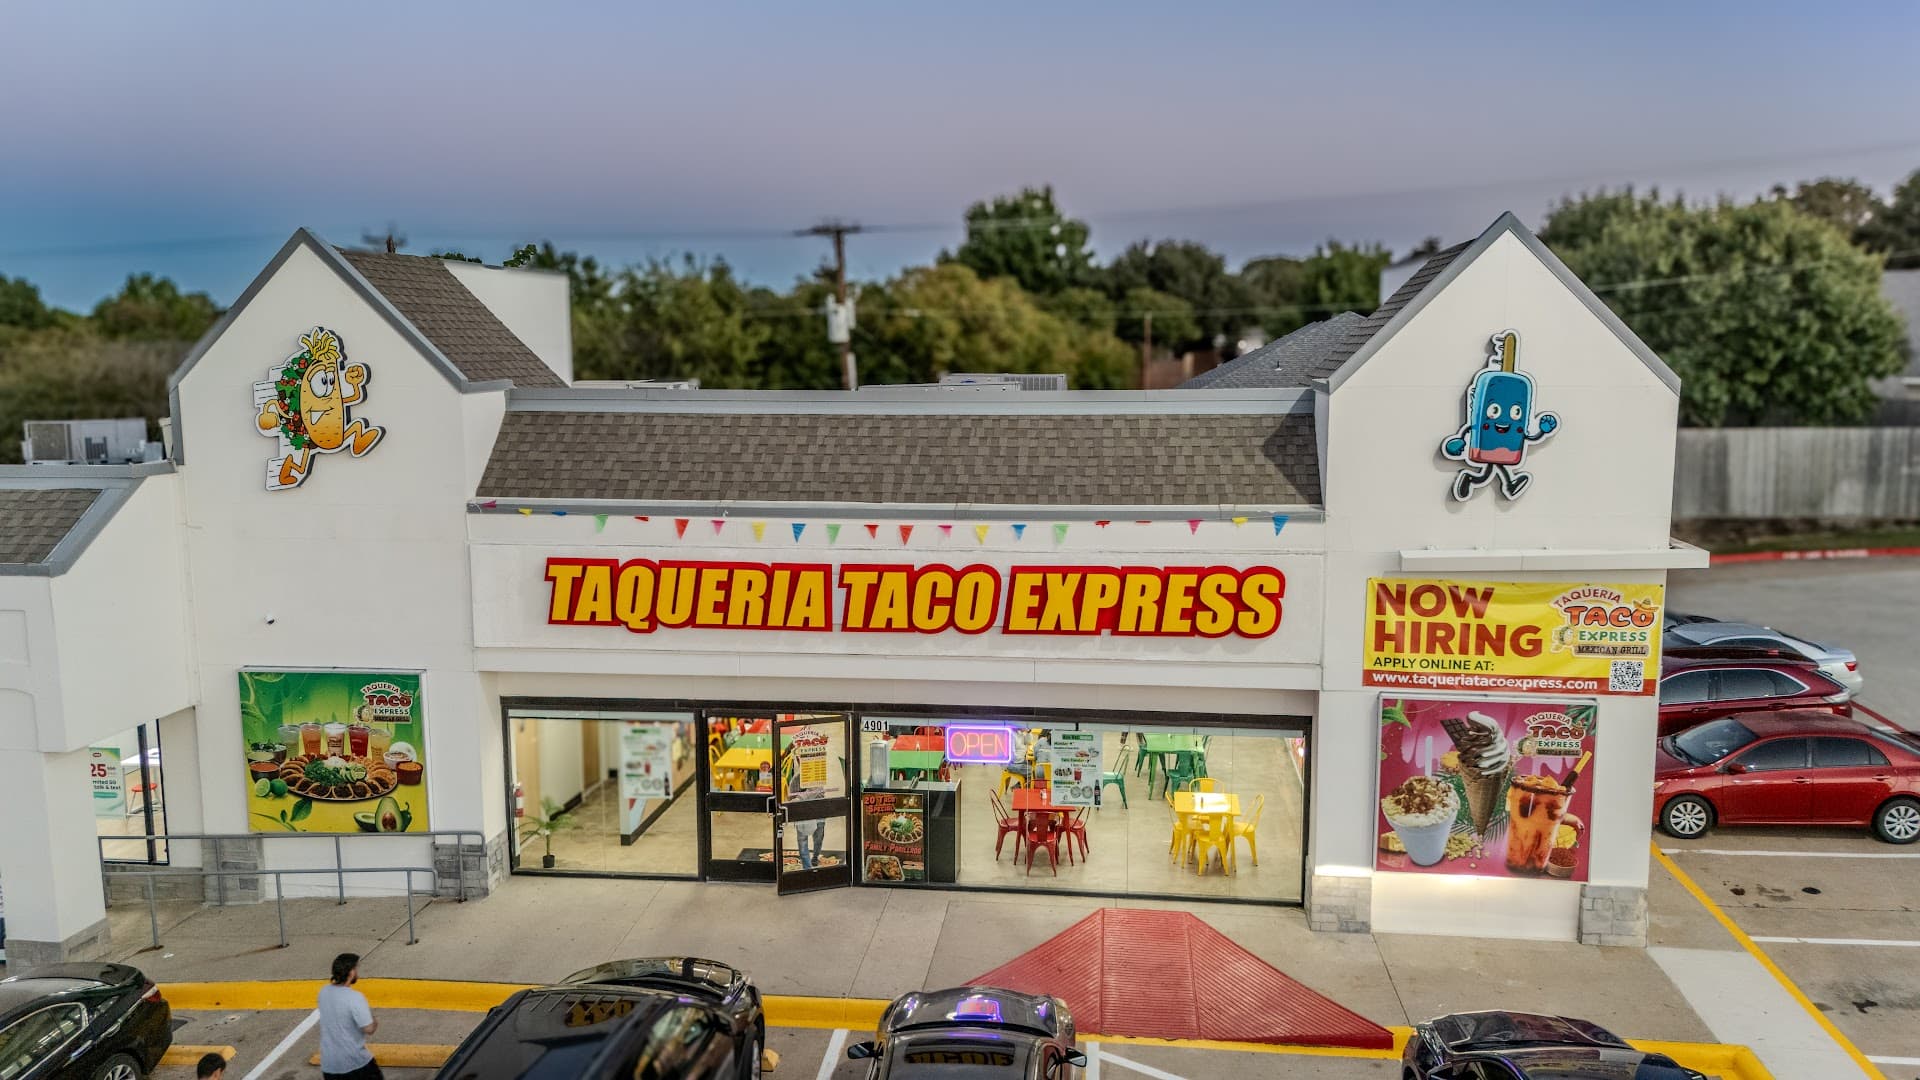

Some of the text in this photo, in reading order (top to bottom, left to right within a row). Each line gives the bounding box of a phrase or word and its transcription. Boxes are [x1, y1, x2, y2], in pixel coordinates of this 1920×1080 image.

[546, 562, 1284, 637] TAQUERIA TACO EXPRESS
[1376, 583, 1495, 619] NOW
[1553, 588, 1622, 608] TAQUERIA
[1564, 605, 1654, 627] TACO
[1374, 620, 1543, 657] HIRING
[1578, 630, 1648, 642] EXPRESS
[1576, 645, 1647, 655] MEXICAN GRILL
[1373, 657, 1495, 671] APPLY ONLINE AT:
[1372, 672, 1598, 692] www.taqueriatacoexpress.com
[363, 684, 399, 693] TAQUERIA
[365, 695, 411, 707] TACO
[1527, 713, 1570, 724] TAQUERIA
[864, 720, 889, 731] 4901
[1529, 726, 1584, 739] TACO
[795, 738, 828, 746] TACO
[949, 731, 1009, 758] OPEN
[1538, 740, 1580, 748] EXPRESS
[864, 796, 875, 805] 20
